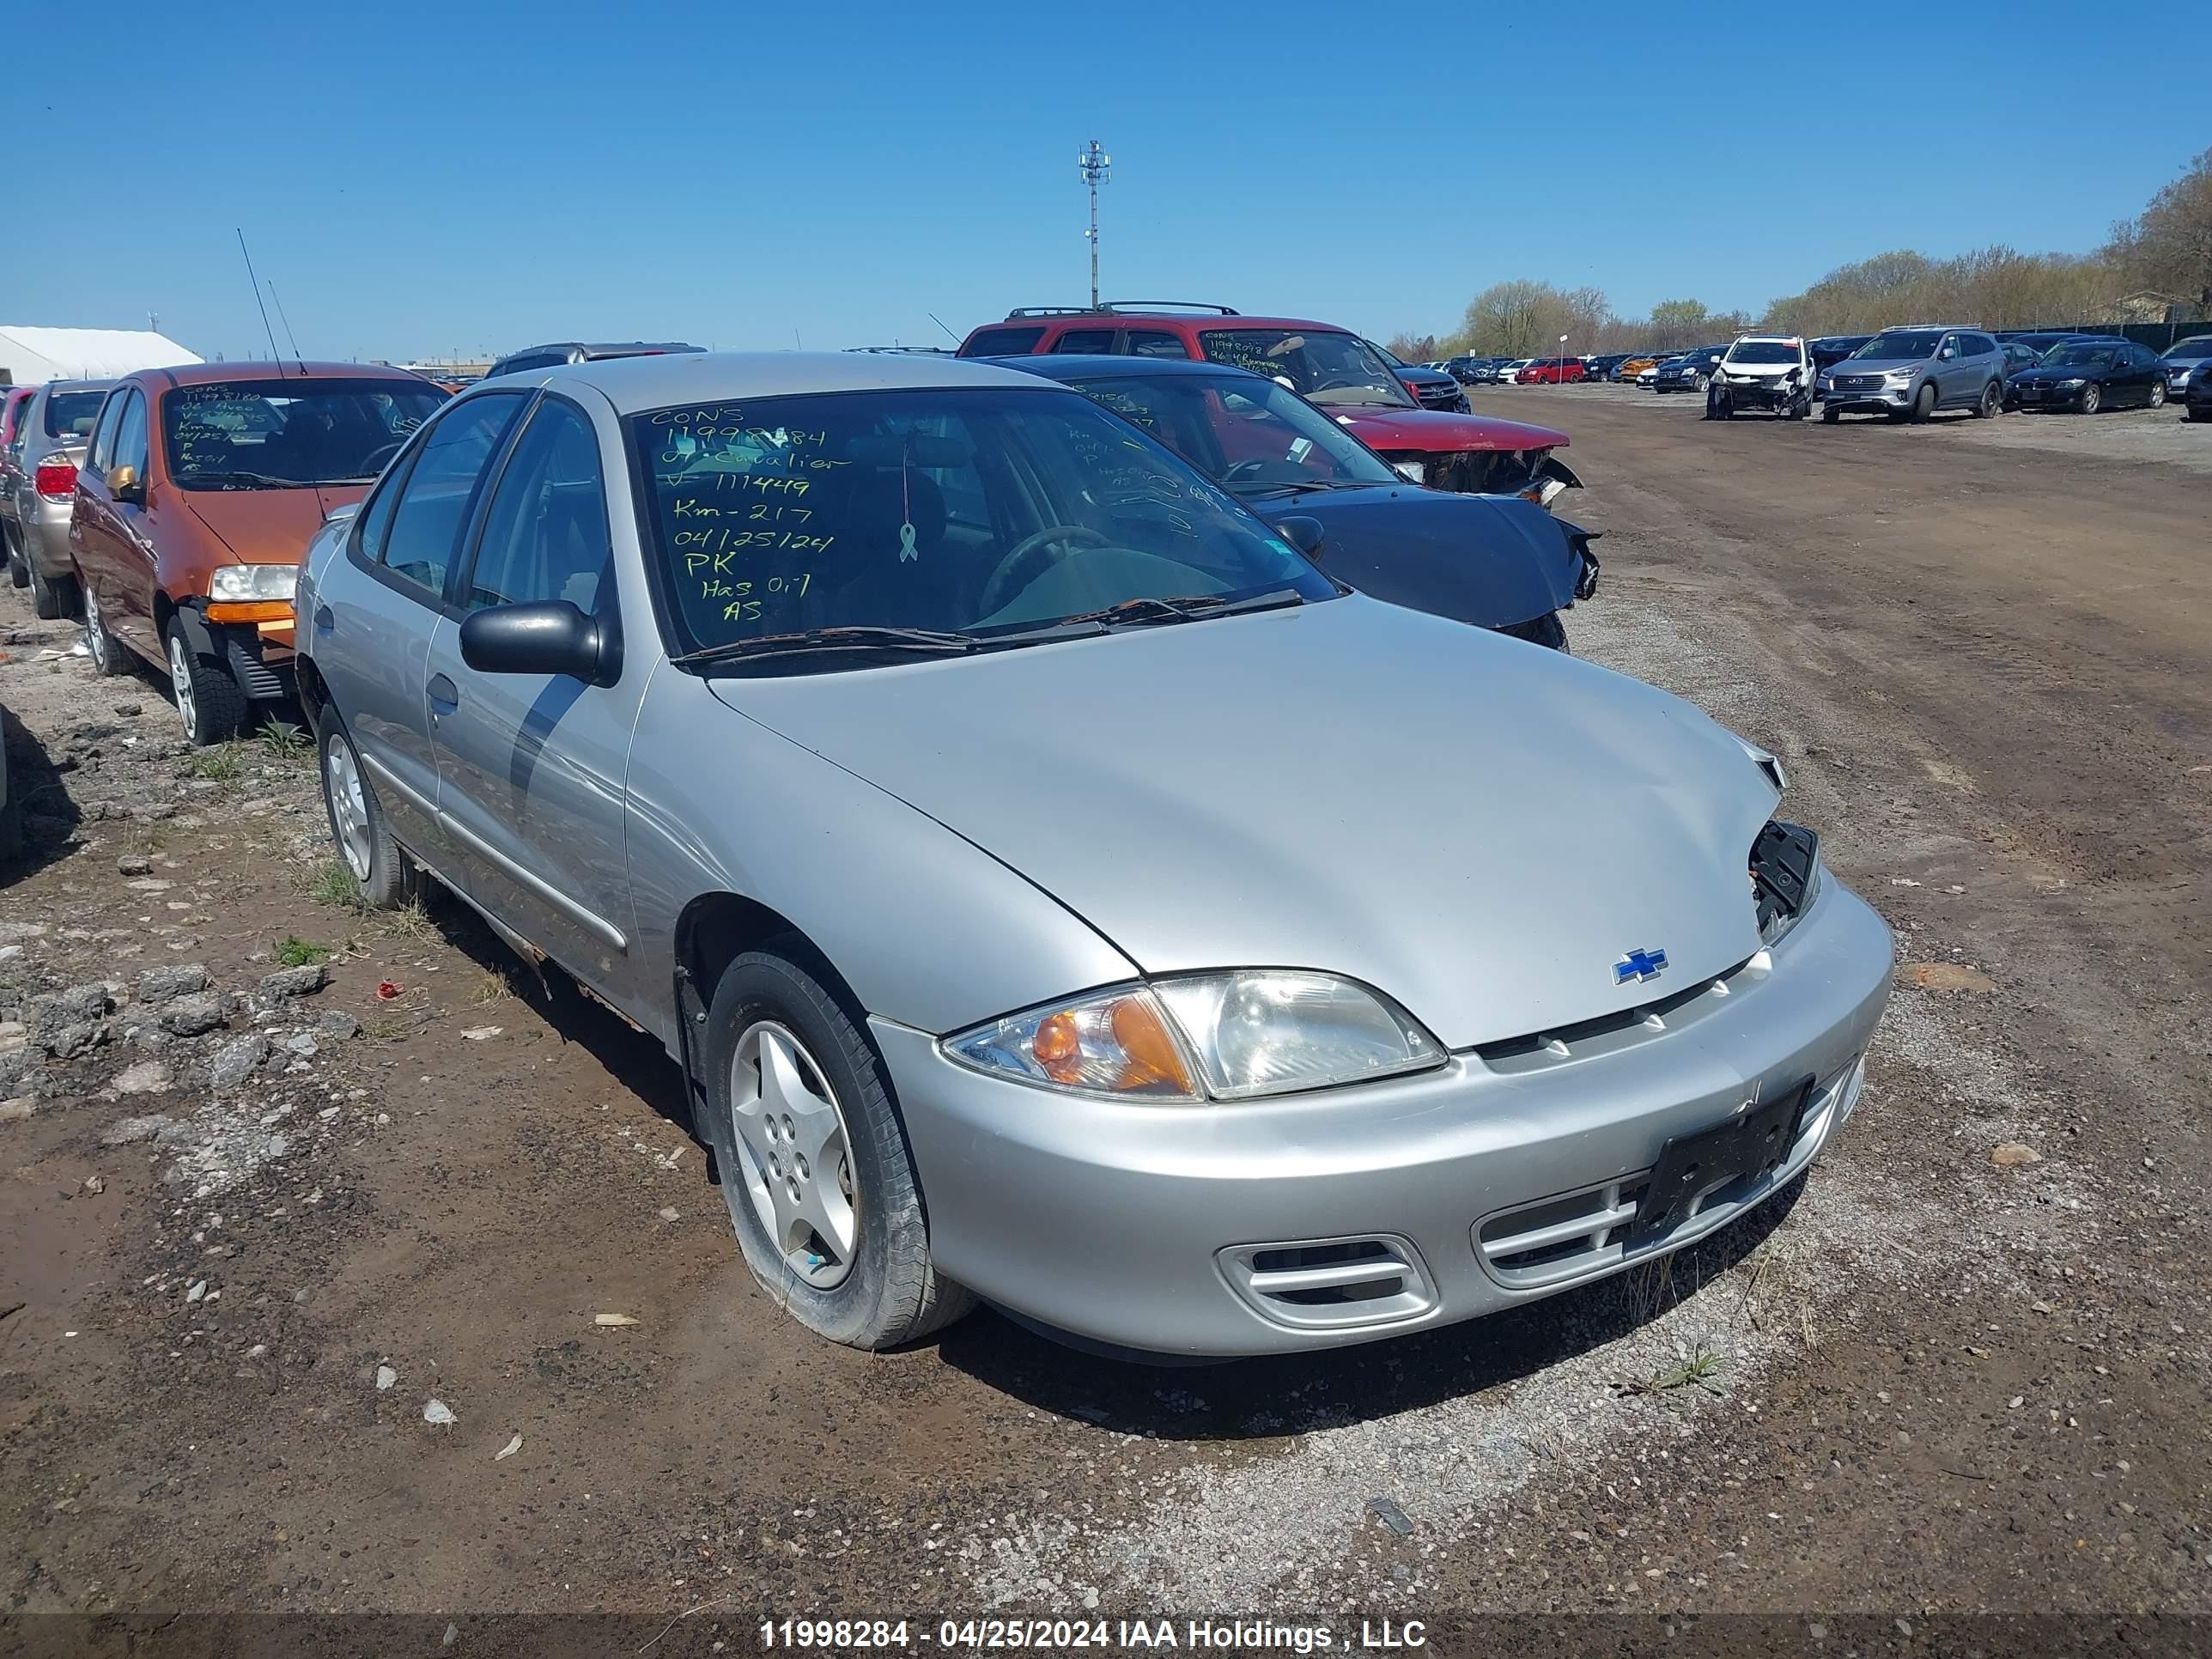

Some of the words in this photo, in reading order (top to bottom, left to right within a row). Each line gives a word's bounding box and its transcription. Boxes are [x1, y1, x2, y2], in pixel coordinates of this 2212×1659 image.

[667, 425, 825, 447] 1199884
[685, 551, 737, 578] PK
[702, 579, 753, 600] Has
[723, 601, 762, 621] AS
